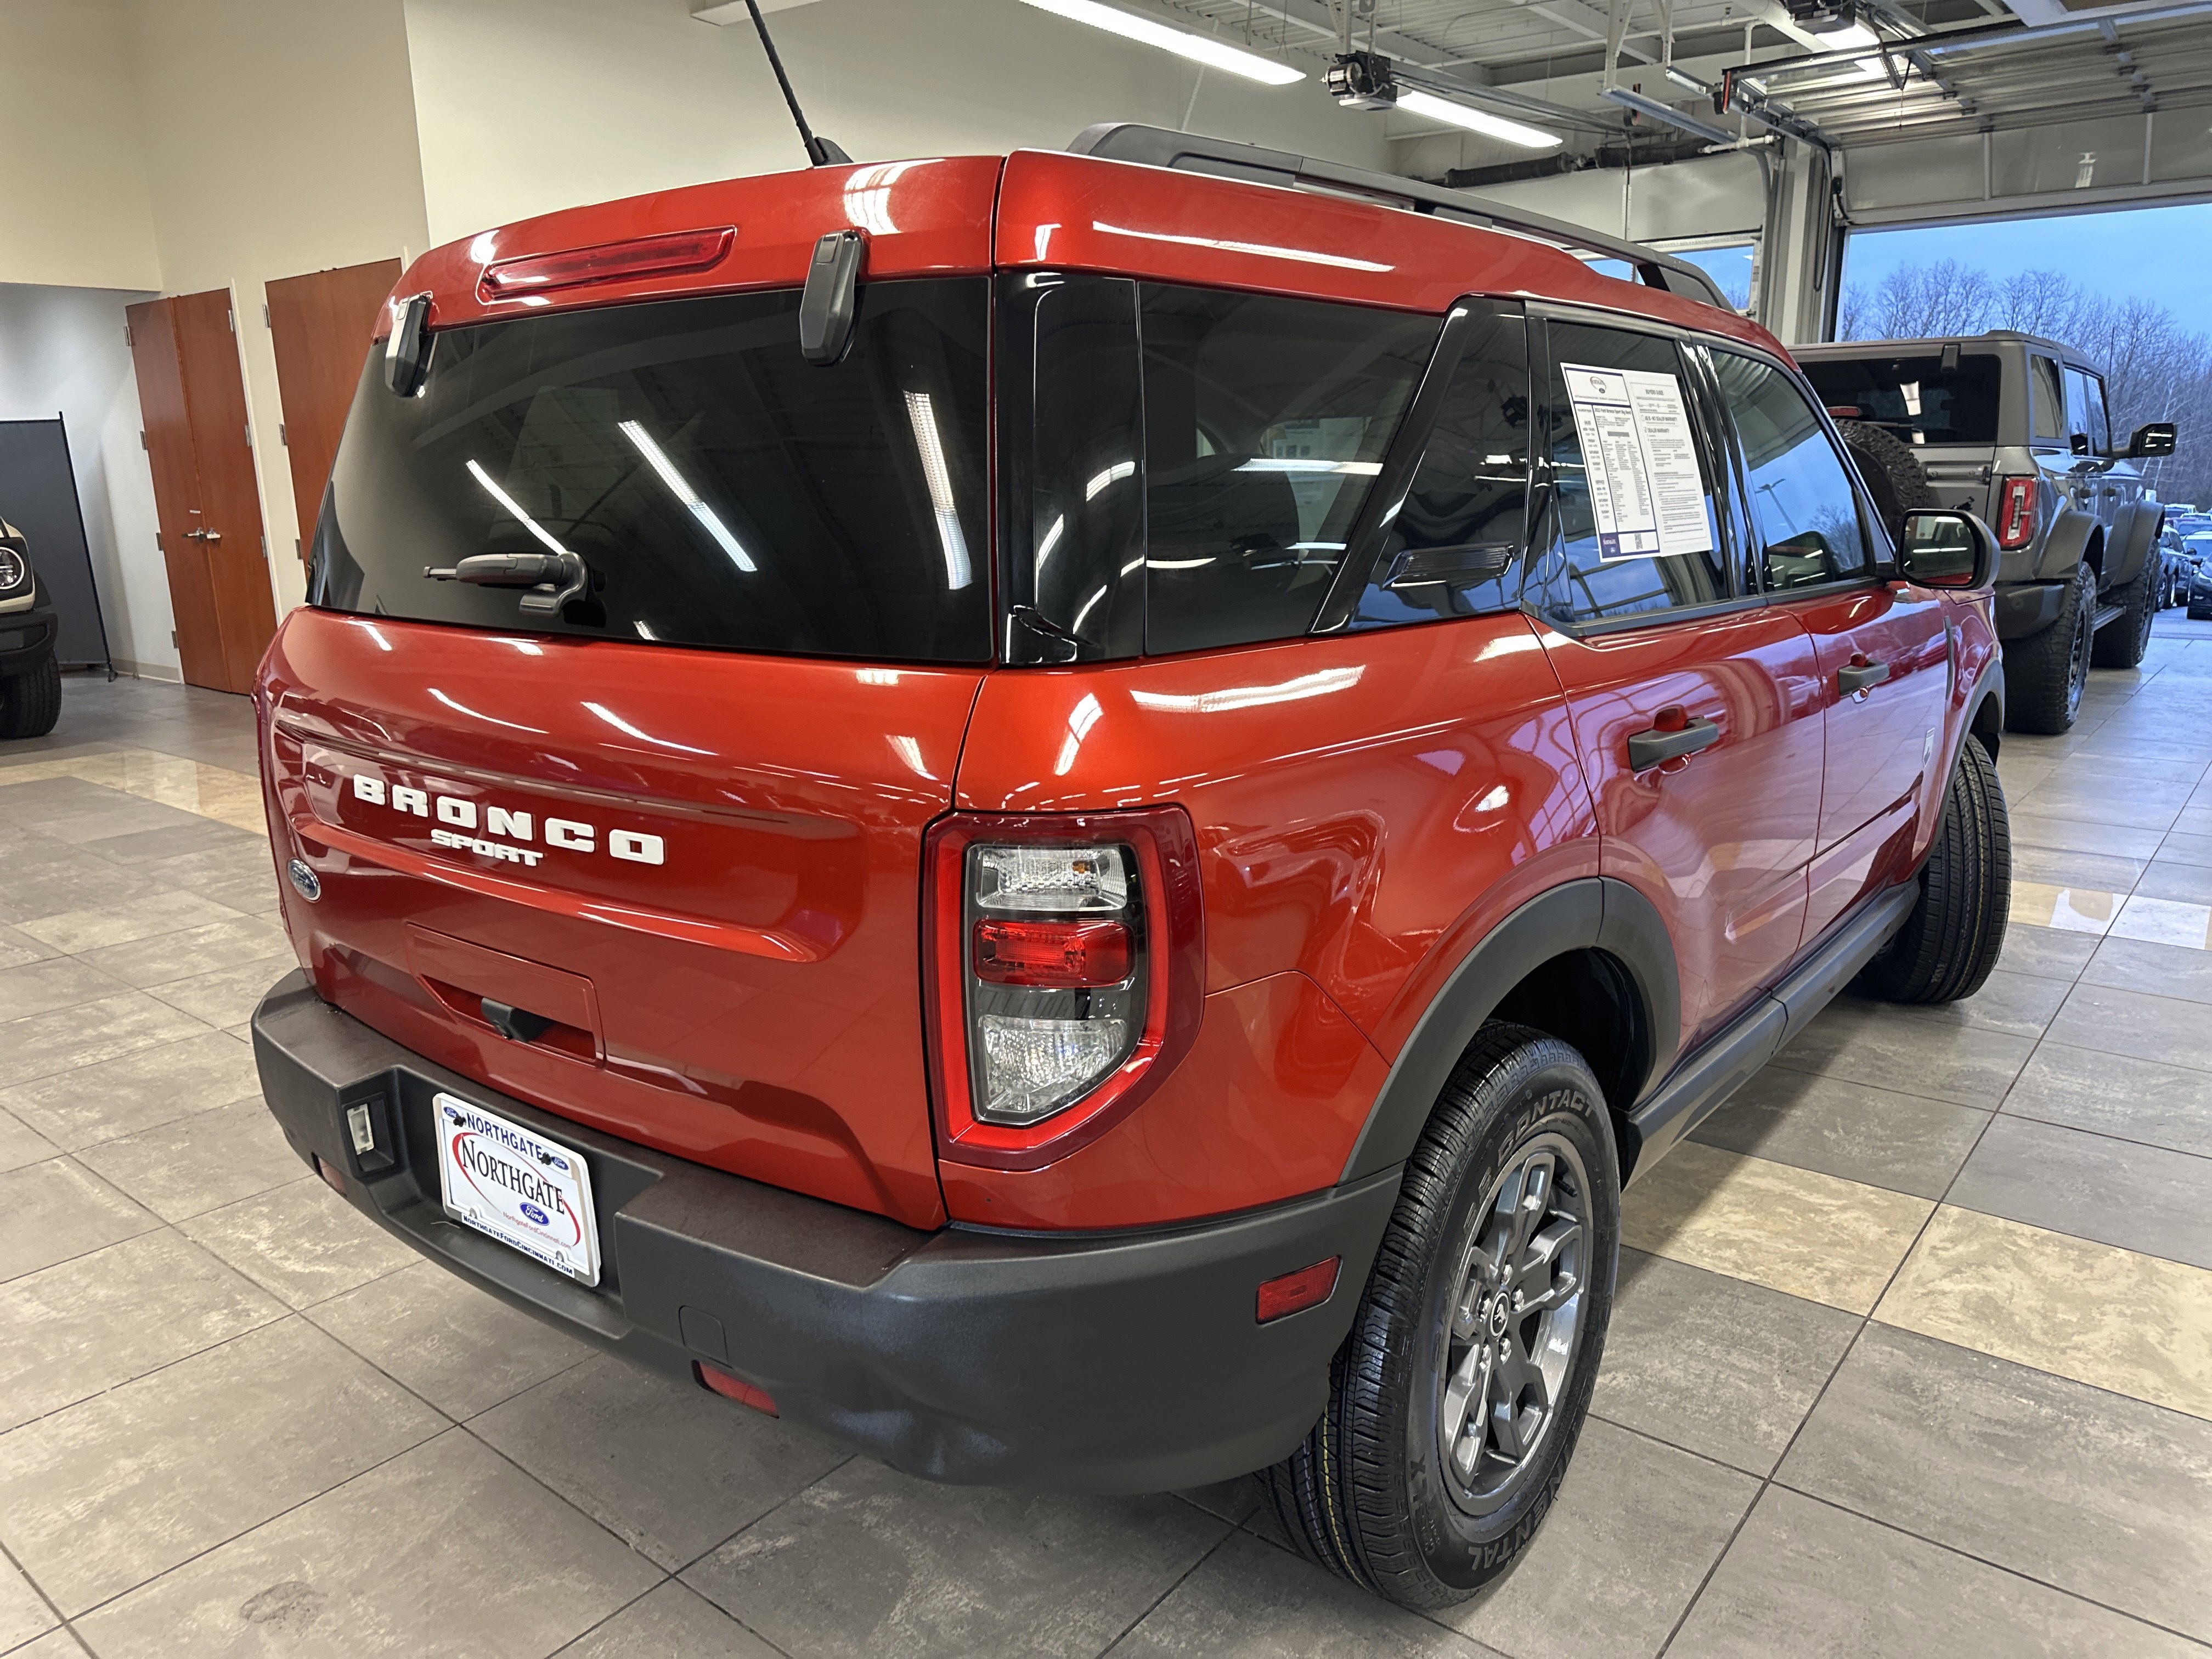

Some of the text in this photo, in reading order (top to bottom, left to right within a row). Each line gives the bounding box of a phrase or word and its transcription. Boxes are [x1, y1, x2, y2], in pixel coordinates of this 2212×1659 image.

[354, 773, 665, 865] BRONCO
[431, 829, 544, 866] SPORT
[466, 1112, 542, 1158] NORTHGATE
[461, 1134, 565, 1215] NORTHGATE
[525, 1205, 544, 1223] Ford
